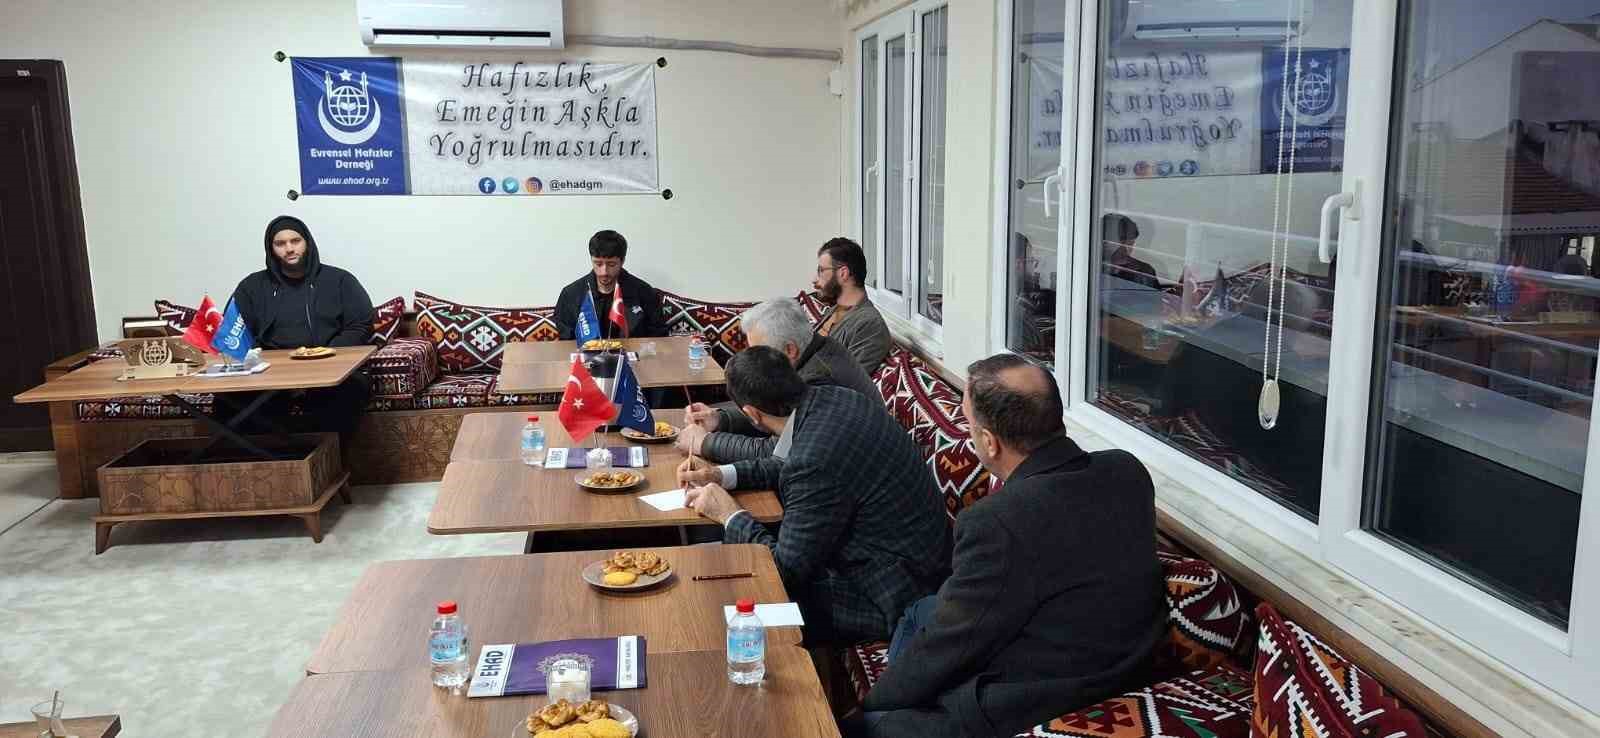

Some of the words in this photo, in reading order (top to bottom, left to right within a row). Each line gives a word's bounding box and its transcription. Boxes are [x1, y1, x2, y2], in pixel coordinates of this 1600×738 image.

[461, 62, 607, 96] Hafızlık,
[436, 98, 546, 131] Emeğin
[553, 96, 639, 128] Aşkla
[310, 148, 352, 158] Evrensel
[354, 148, 393, 158] Hafızlar
[429, 131, 647, 165] Yoğrulmasıdır.
[335, 159, 374, 171] Derneği
[318, 176, 390, 187] www.ehad.org.tr
[550, 179, 603, 191] @ehadgm
[480, 650, 504, 677] EHAD
